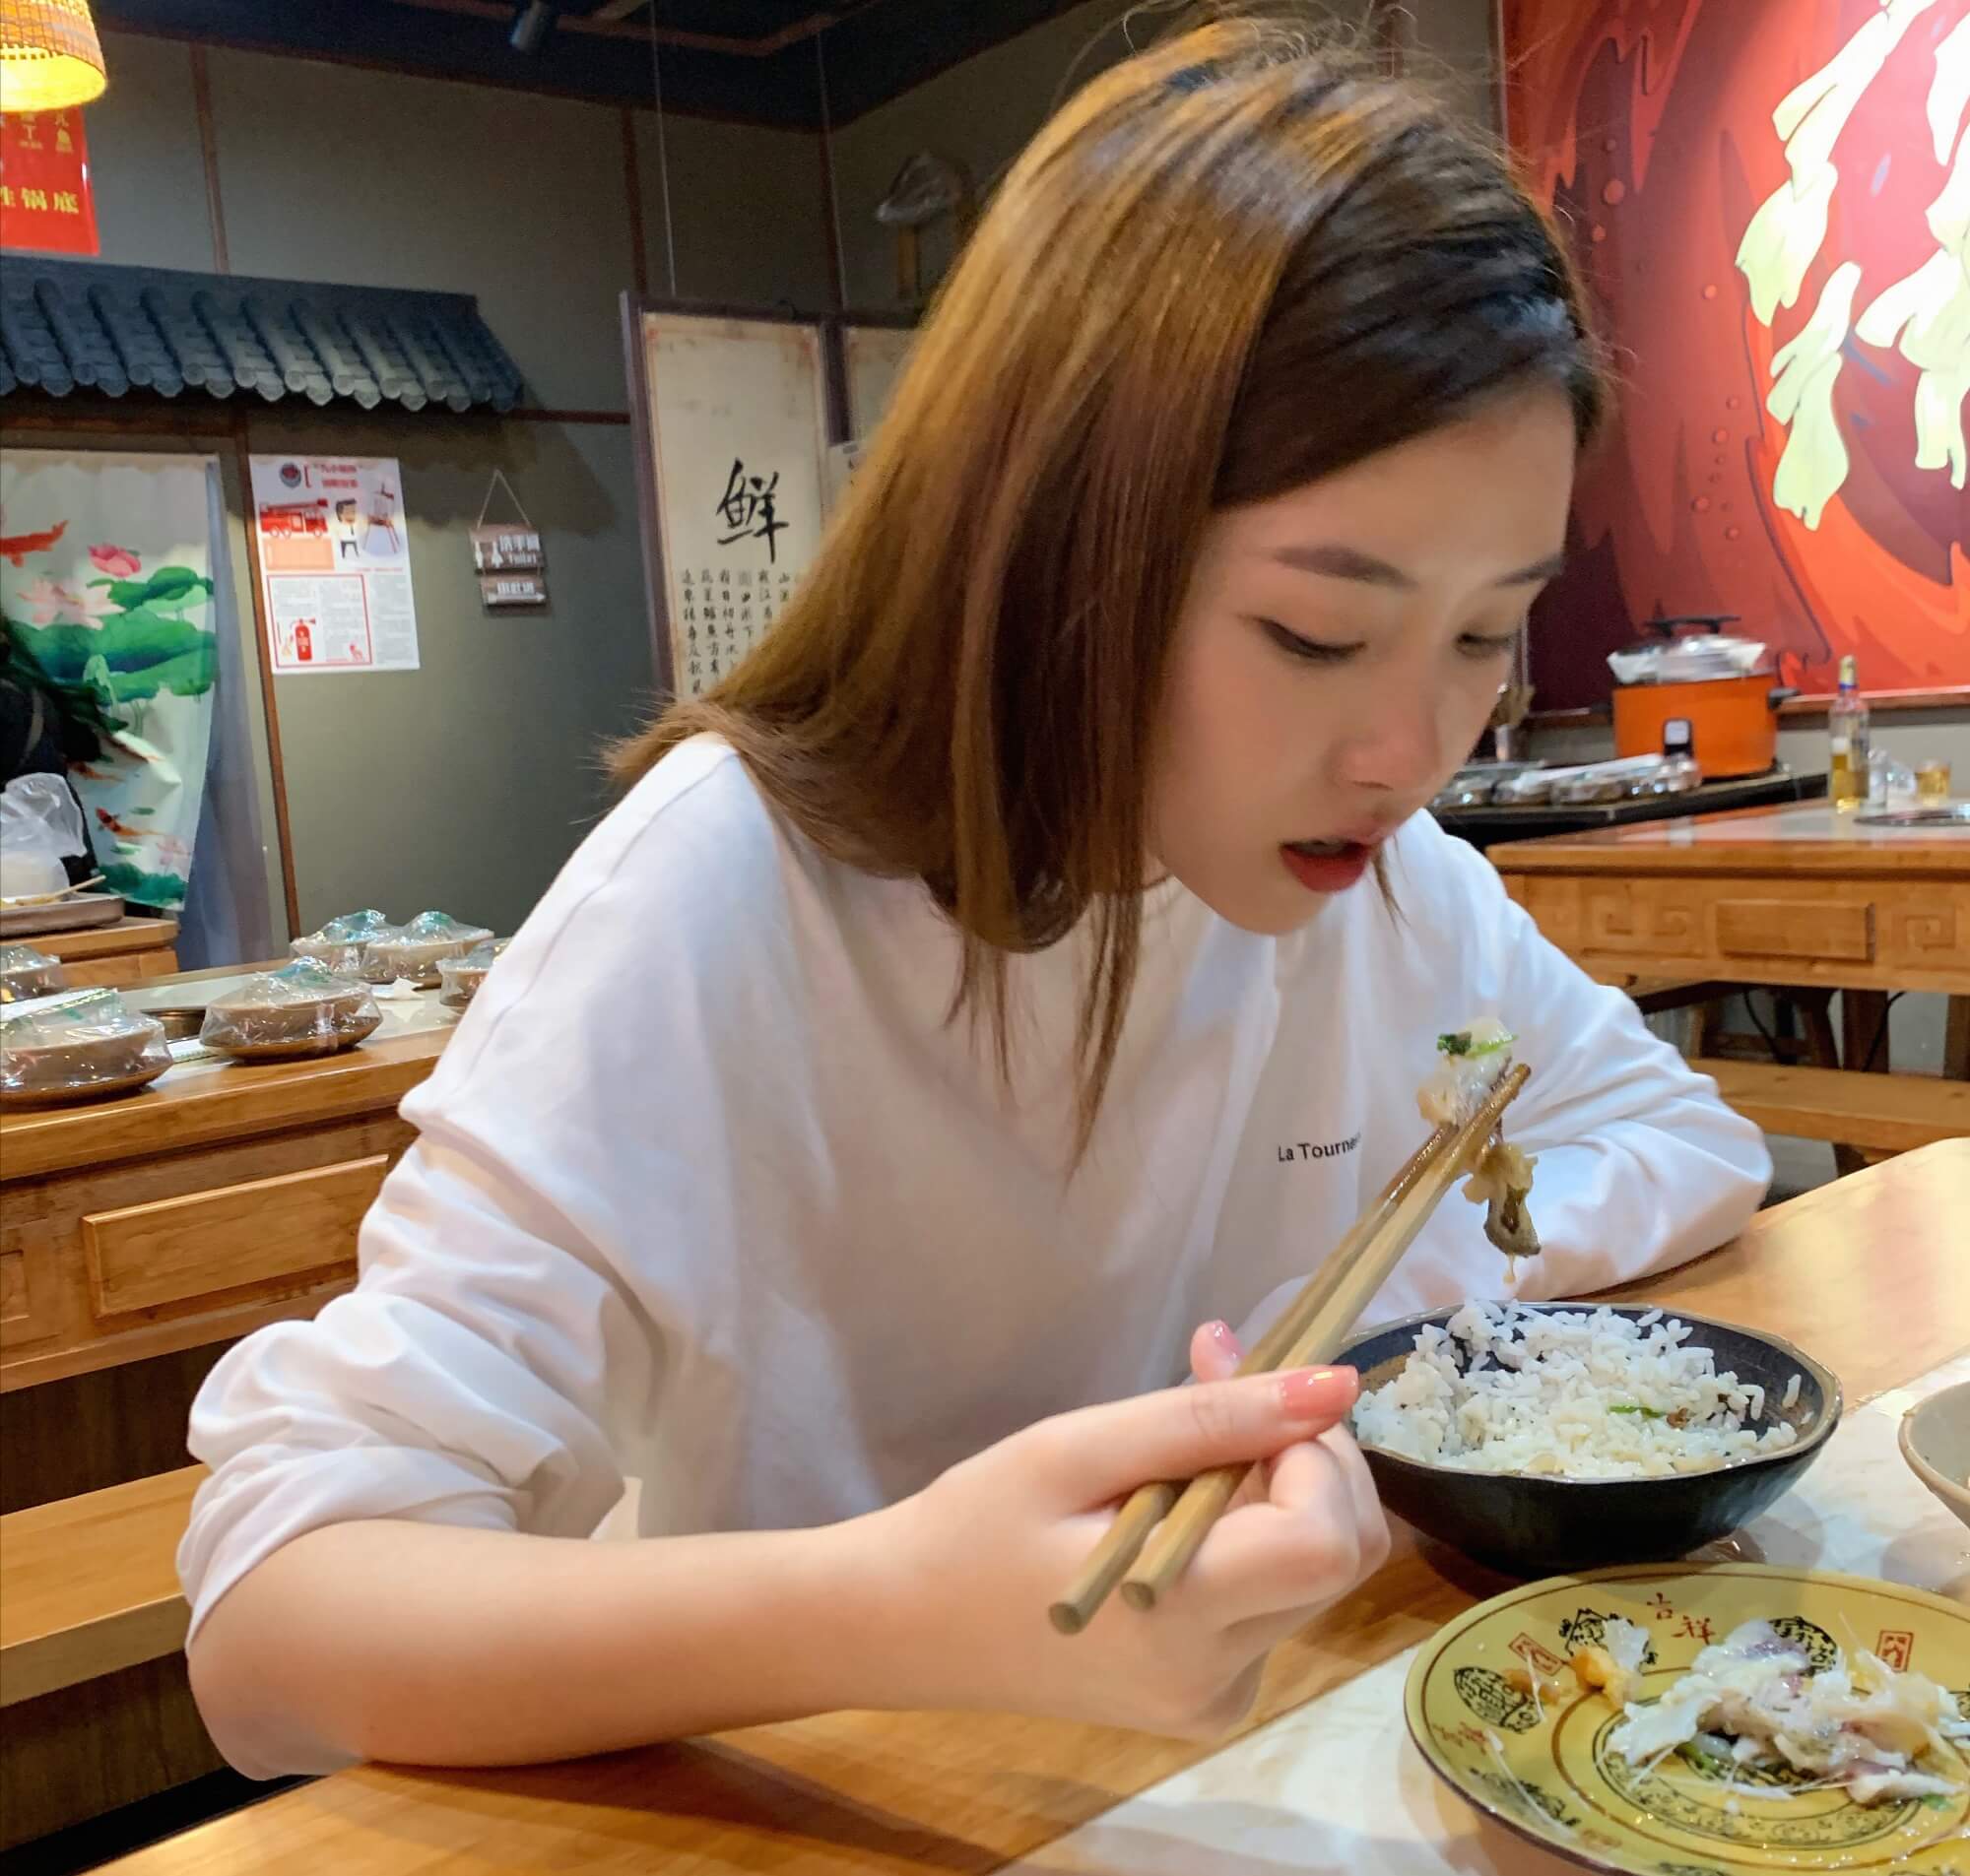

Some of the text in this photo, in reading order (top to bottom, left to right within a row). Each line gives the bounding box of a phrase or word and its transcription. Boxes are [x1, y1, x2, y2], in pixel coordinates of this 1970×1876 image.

[716, 457, 789, 563] 鲜
[1278, 1145, 1294, 1162] La
[1646, 1591, 1716, 1646] 吉祥
